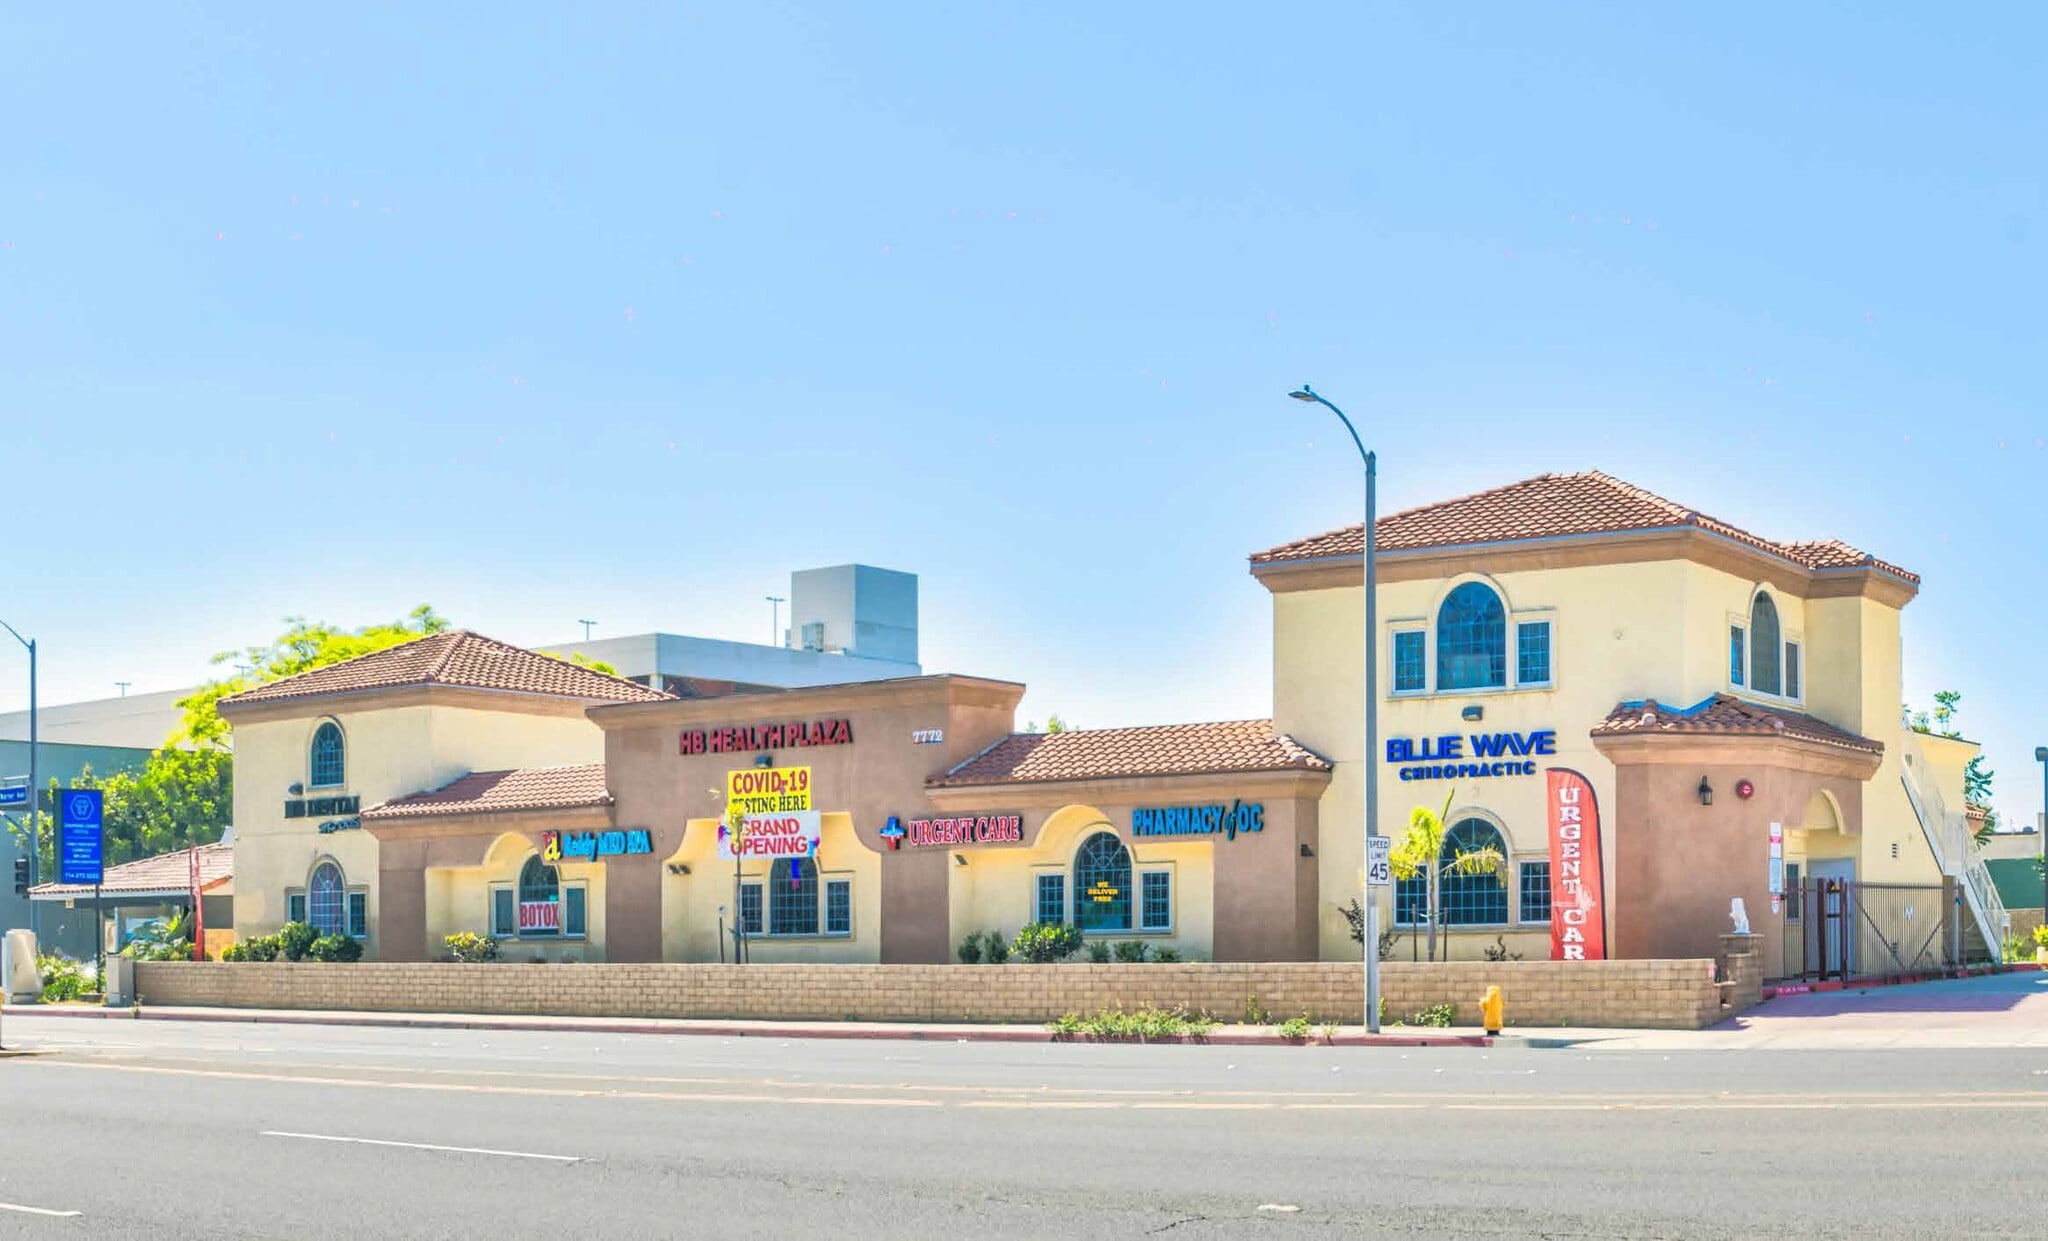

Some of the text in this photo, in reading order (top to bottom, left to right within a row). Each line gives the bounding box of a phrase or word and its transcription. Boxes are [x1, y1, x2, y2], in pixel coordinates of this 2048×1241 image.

[679, 718, 854, 755] HB HEALTH PLAZA
[913, 729, 943, 743] 7772
[1386, 730, 1557, 762] BLUE WAVE
[732, 770, 808, 795] COVID-19
[1400, 761, 1536, 781] CHIROPRACTIC
[732, 795, 807, 814] STING HERE
[908, 816, 1022, 845] URGENT CARE
[1132, 806, 1225, 837] PHARMACY
[1237, 803, 1264, 833] OC
[1369, 840, 1389, 849] SPEED
[1559, 787, 1582, 895] URGENT
[1370, 850, 1387, 860] LIMIT
[1370, 863, 1388, 881] 45
[519, 903, 558, 927] BOTOX
